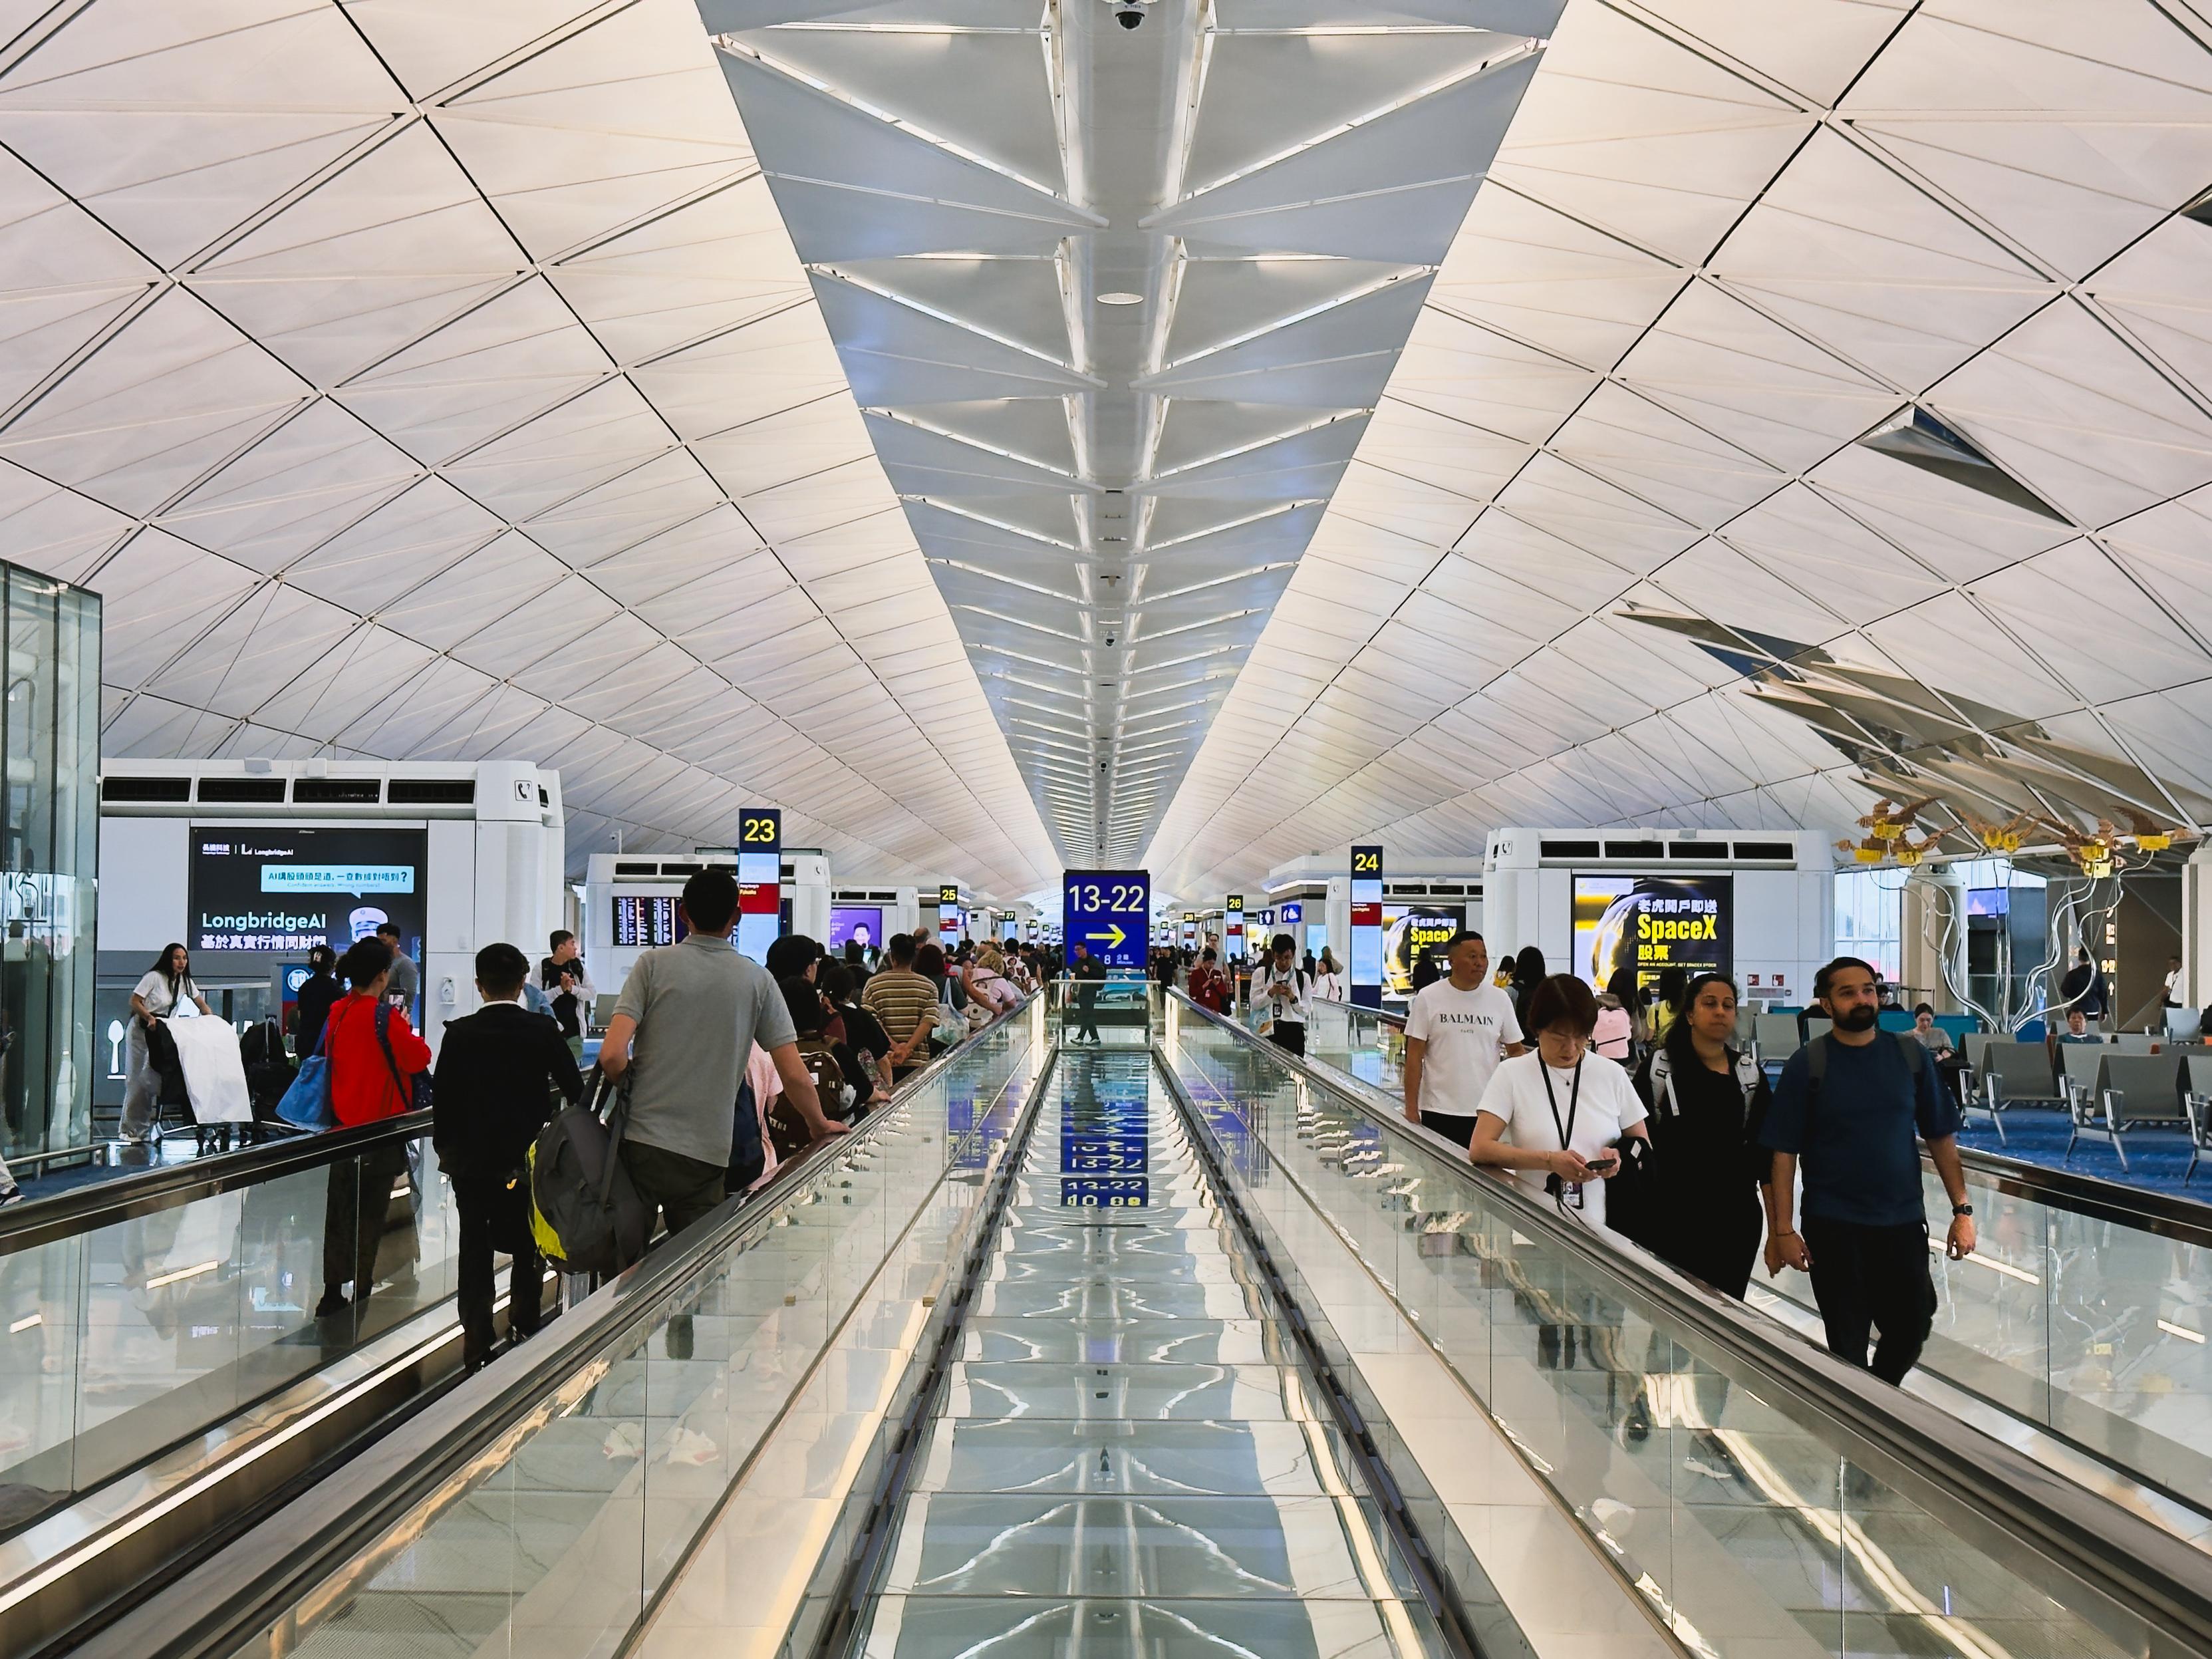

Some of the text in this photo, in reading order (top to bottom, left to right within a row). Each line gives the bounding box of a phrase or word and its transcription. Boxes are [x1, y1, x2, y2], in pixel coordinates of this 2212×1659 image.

[744, 819, 775, 842] 23
[1355, 853, 1379, 871] 24
[942, 889, 956, 901] 25
[1069, 885, 1144, 912] 13-22
[1228, 899, 1242, 909] 26
[202, 912, 326, 932] LongbridgeAI
[1637, 913, 1717, 944] SpaceX
[1104, 955, 1111, 965] 8
[1440, 1014, 1493, 1025] BALMAIN
